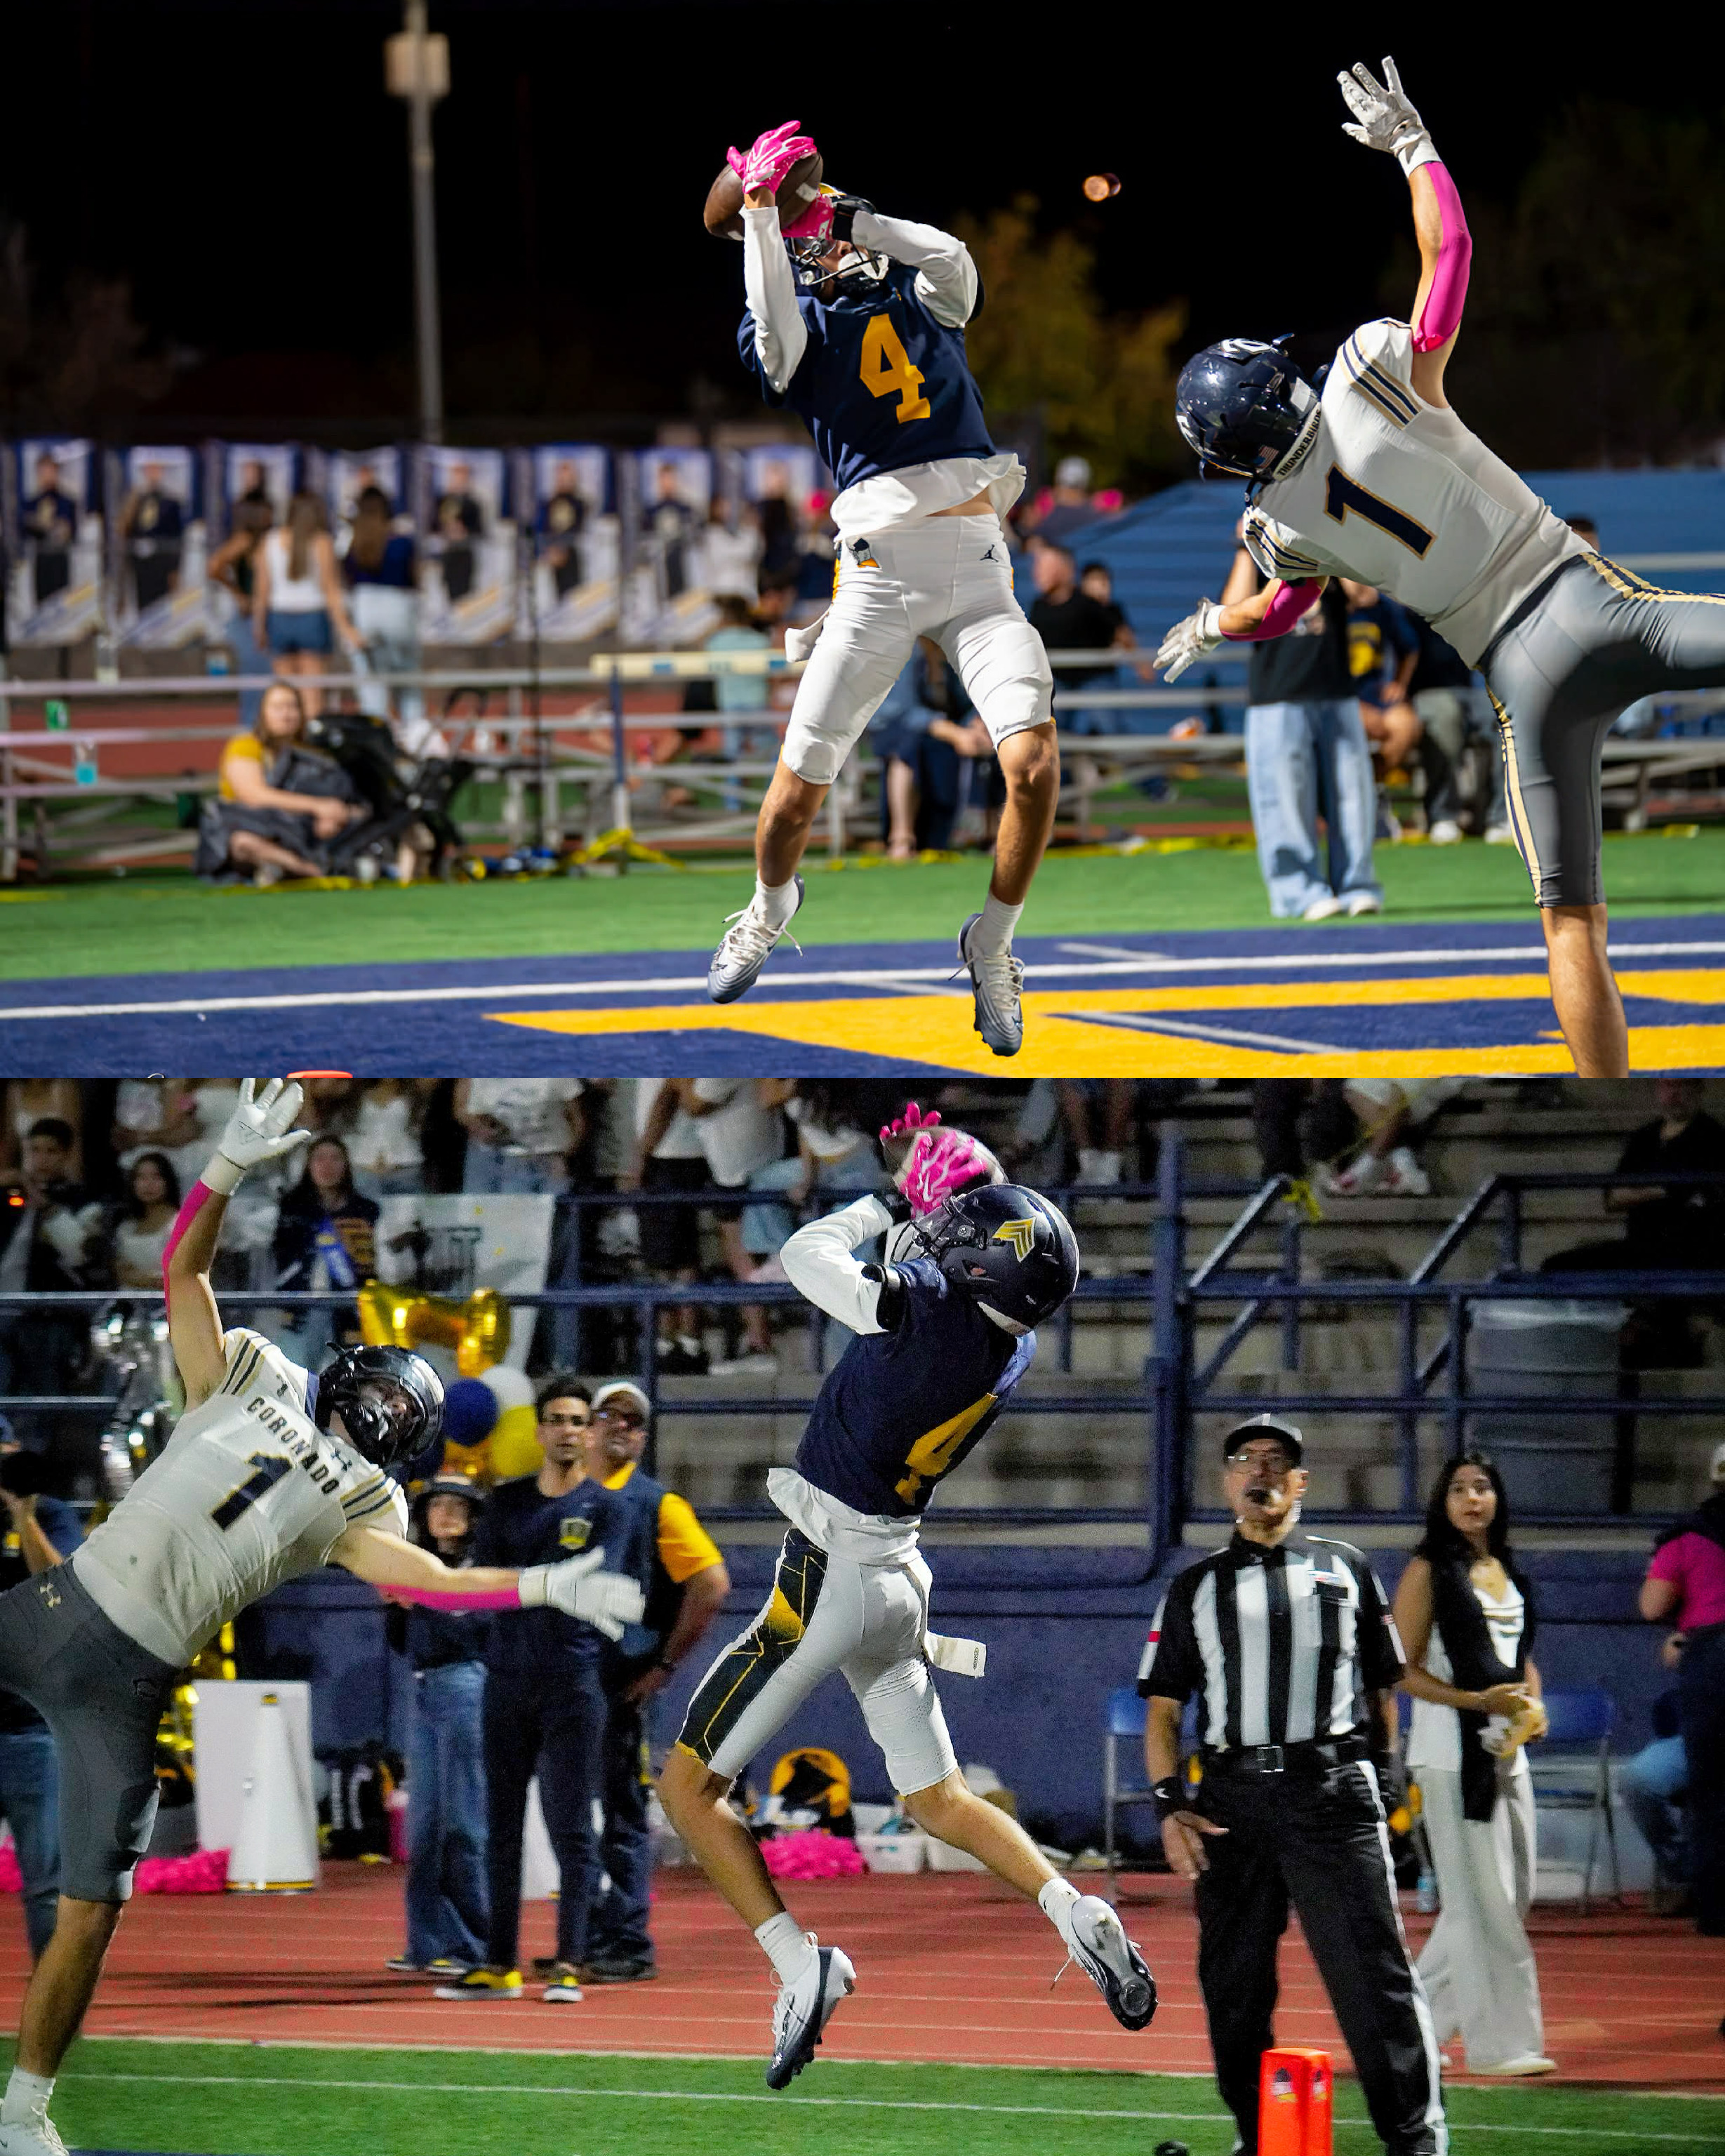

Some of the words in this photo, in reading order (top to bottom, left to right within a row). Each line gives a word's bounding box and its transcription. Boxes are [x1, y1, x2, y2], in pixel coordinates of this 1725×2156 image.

[860, 313, 931, 424] 4
[1324, 461, 1437, 560] 1
[211, 1450, 293, 1532] 1
[247, 1395, 340, 1495] CORONADO
[894, 1392, 998, 1506] 4
